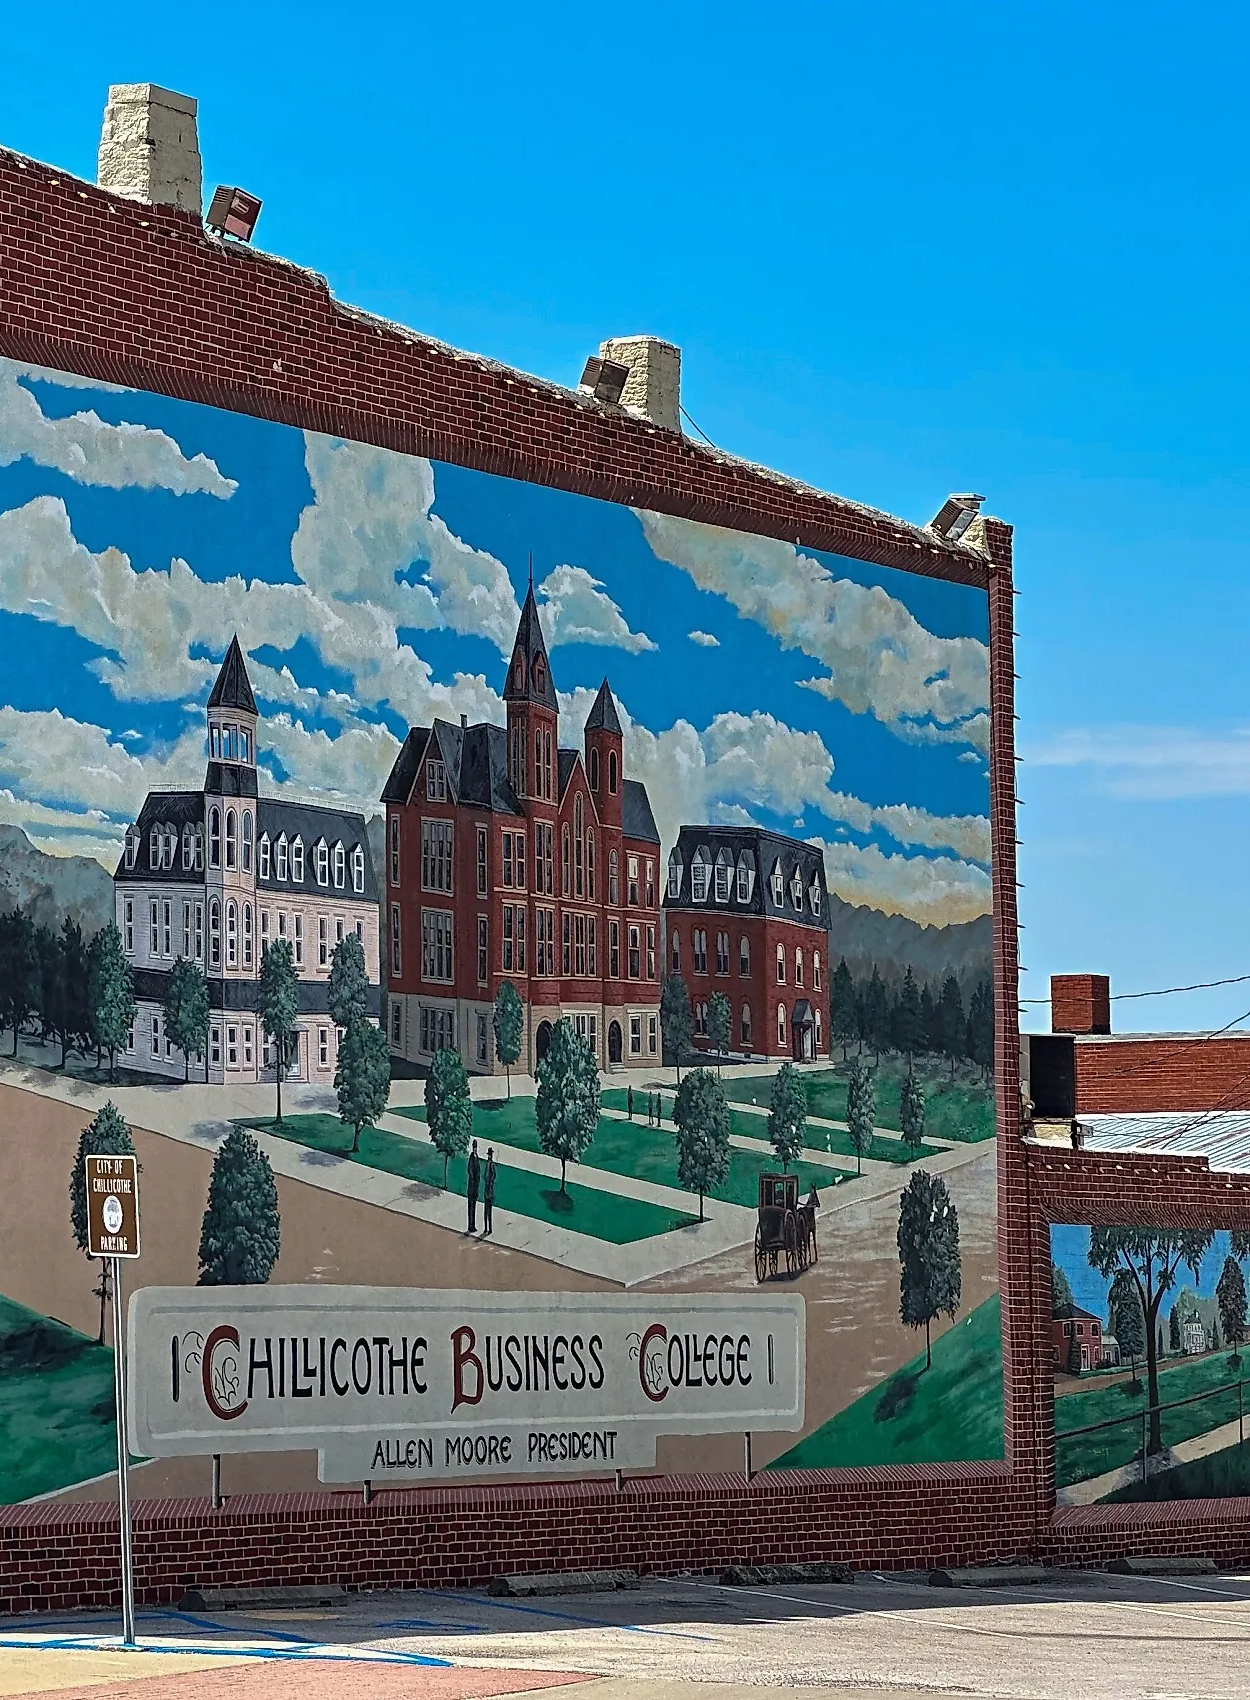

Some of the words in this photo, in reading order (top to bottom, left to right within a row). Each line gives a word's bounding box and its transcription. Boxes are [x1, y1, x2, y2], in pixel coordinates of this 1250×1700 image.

[97, 1160, 112, 1174] CITY
[114, 1160, 123, 1174] OF
[93, 1178, 131, 1193] CHILLICOTHE
[100, 1236, 127, 1251] PARKING
[201, 1324, 429, 1421] CHILLICOTHE
[450, 1324, 606, 1414] BUSINESS
[637, 1323, 753, 1402] COLLEGE
[370, 1433, 434, 1469] ALLEN
[444, 1434, 512, 1466] MOORE
[528, 1430, 619, 1462] PRESIDENT
